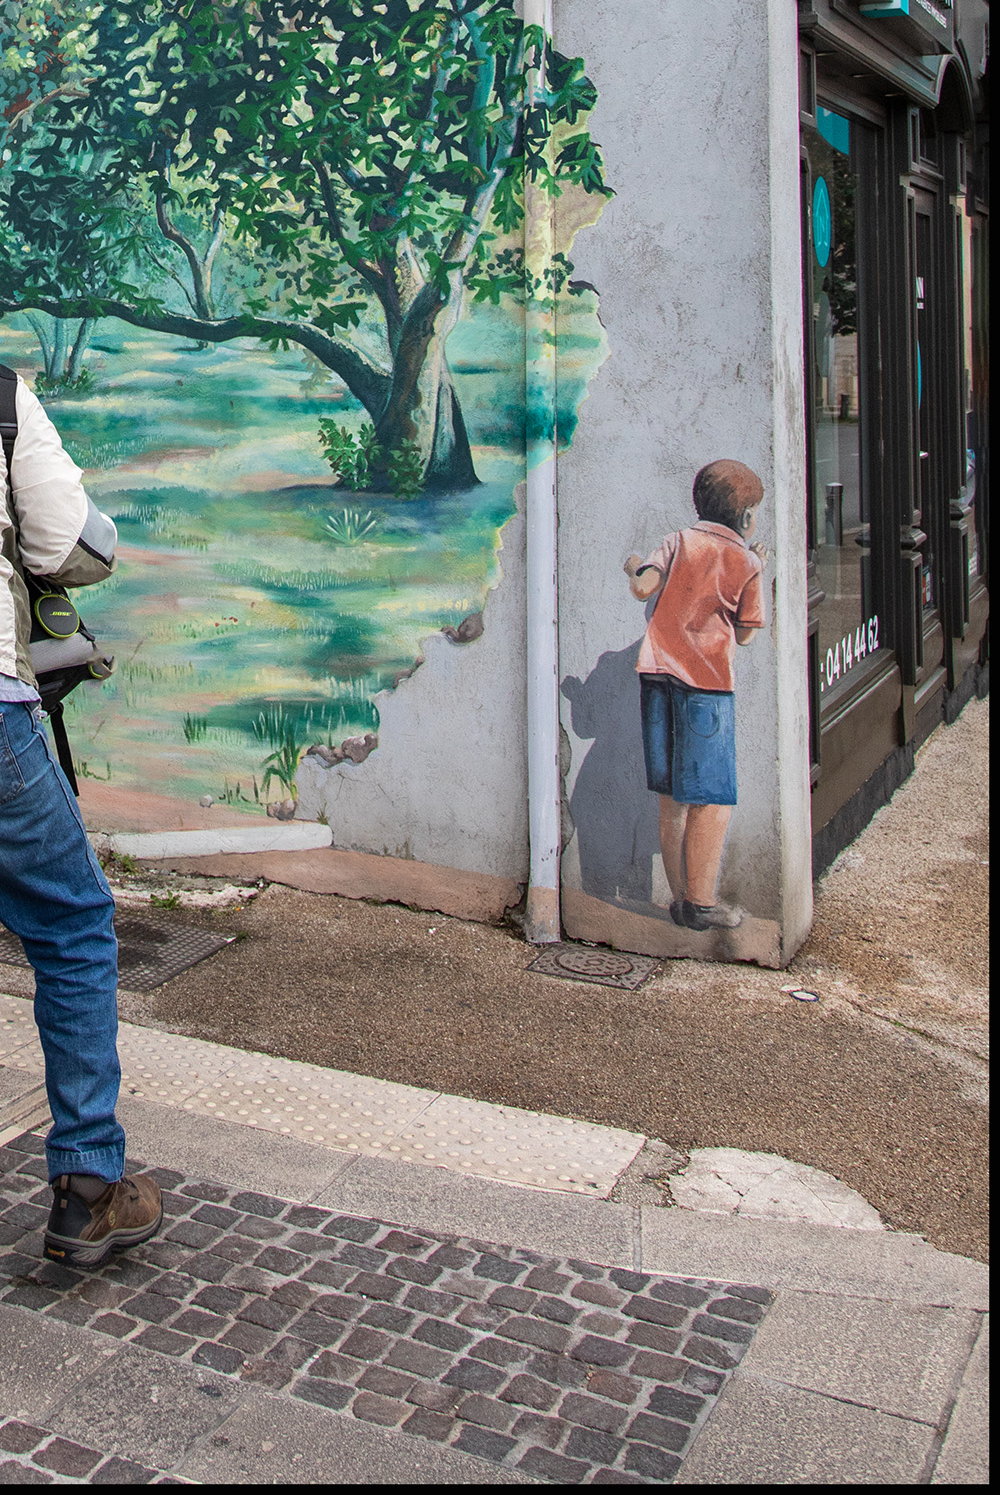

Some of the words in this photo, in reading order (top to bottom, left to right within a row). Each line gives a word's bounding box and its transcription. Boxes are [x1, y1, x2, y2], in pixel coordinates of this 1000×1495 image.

[826, 642, 841, 687] 04
[841, 633, 853, 674] 14
[854, 623, 867, 663] 44
[867, 614, 879, 653] 62
